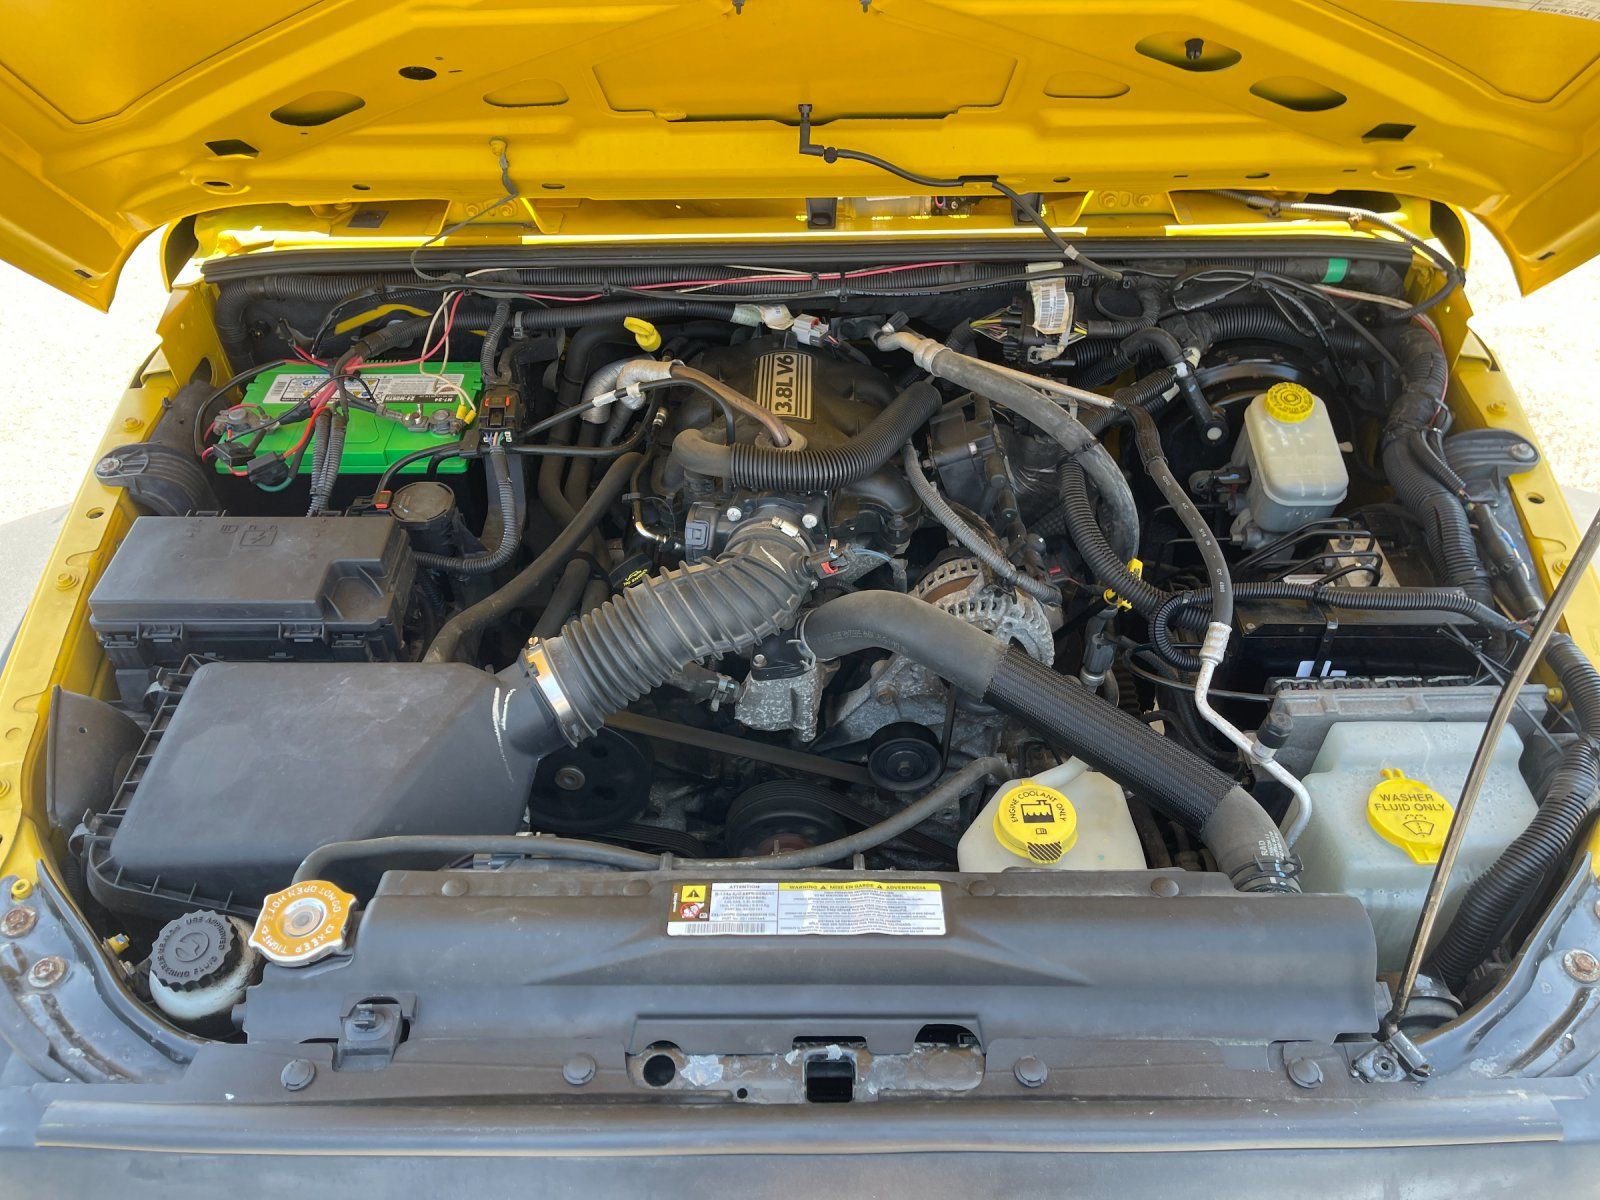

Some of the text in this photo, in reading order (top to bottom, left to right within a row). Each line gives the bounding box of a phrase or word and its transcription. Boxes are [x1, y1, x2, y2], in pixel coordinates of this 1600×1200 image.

[775, 355, 794, 412] 3.8L V6
[1379, 793, 1435, 802] WASHER
[1008, 790, 1066, 823] ENGINE COOLANT ONLY
[1374, 803, 1445, 811] FLUID ONLY
[1258, 840, 1269, 856] RAD
[288, 885, 317, 898] OPEN
[268, 895, 287, 914] HOT
